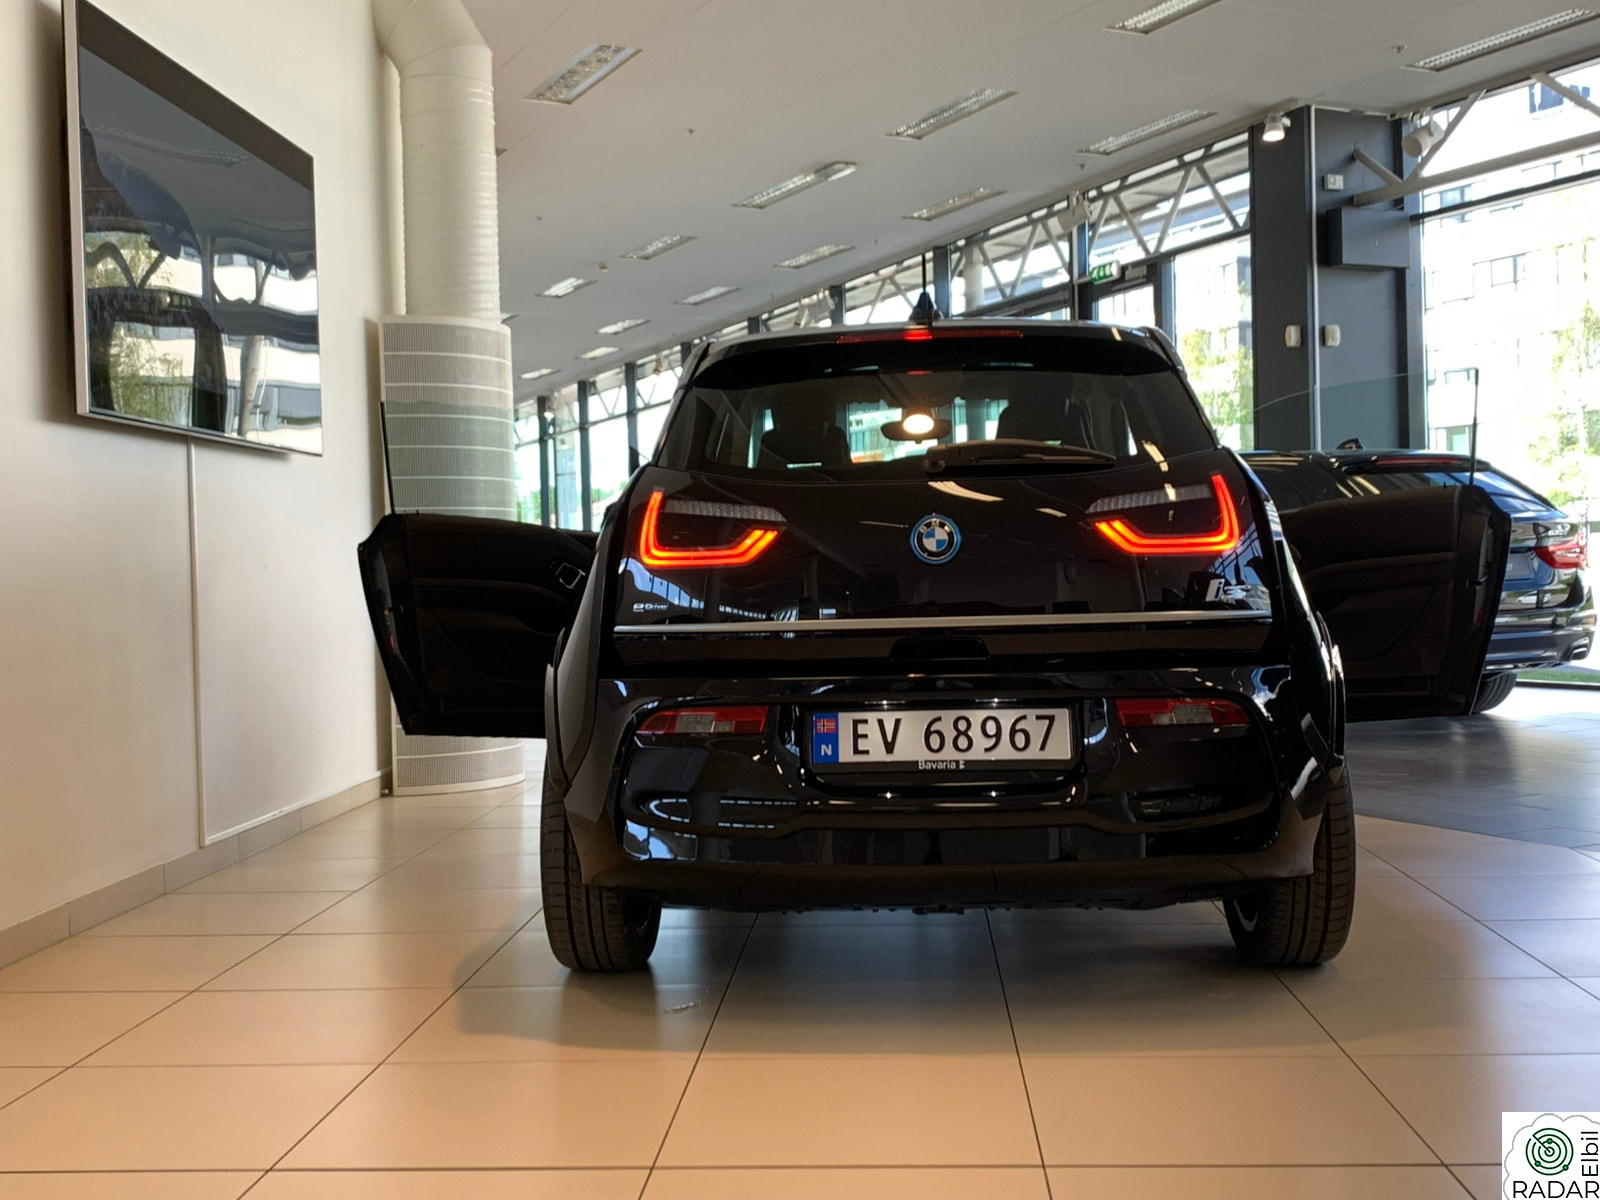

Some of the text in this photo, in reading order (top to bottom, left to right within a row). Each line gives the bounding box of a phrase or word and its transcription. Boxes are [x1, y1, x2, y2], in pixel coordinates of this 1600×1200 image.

[852, 714, 1056, 755] EV 68967
[820, 744, 833, 756] N
[918, 759, 956, 770] Bavaria
